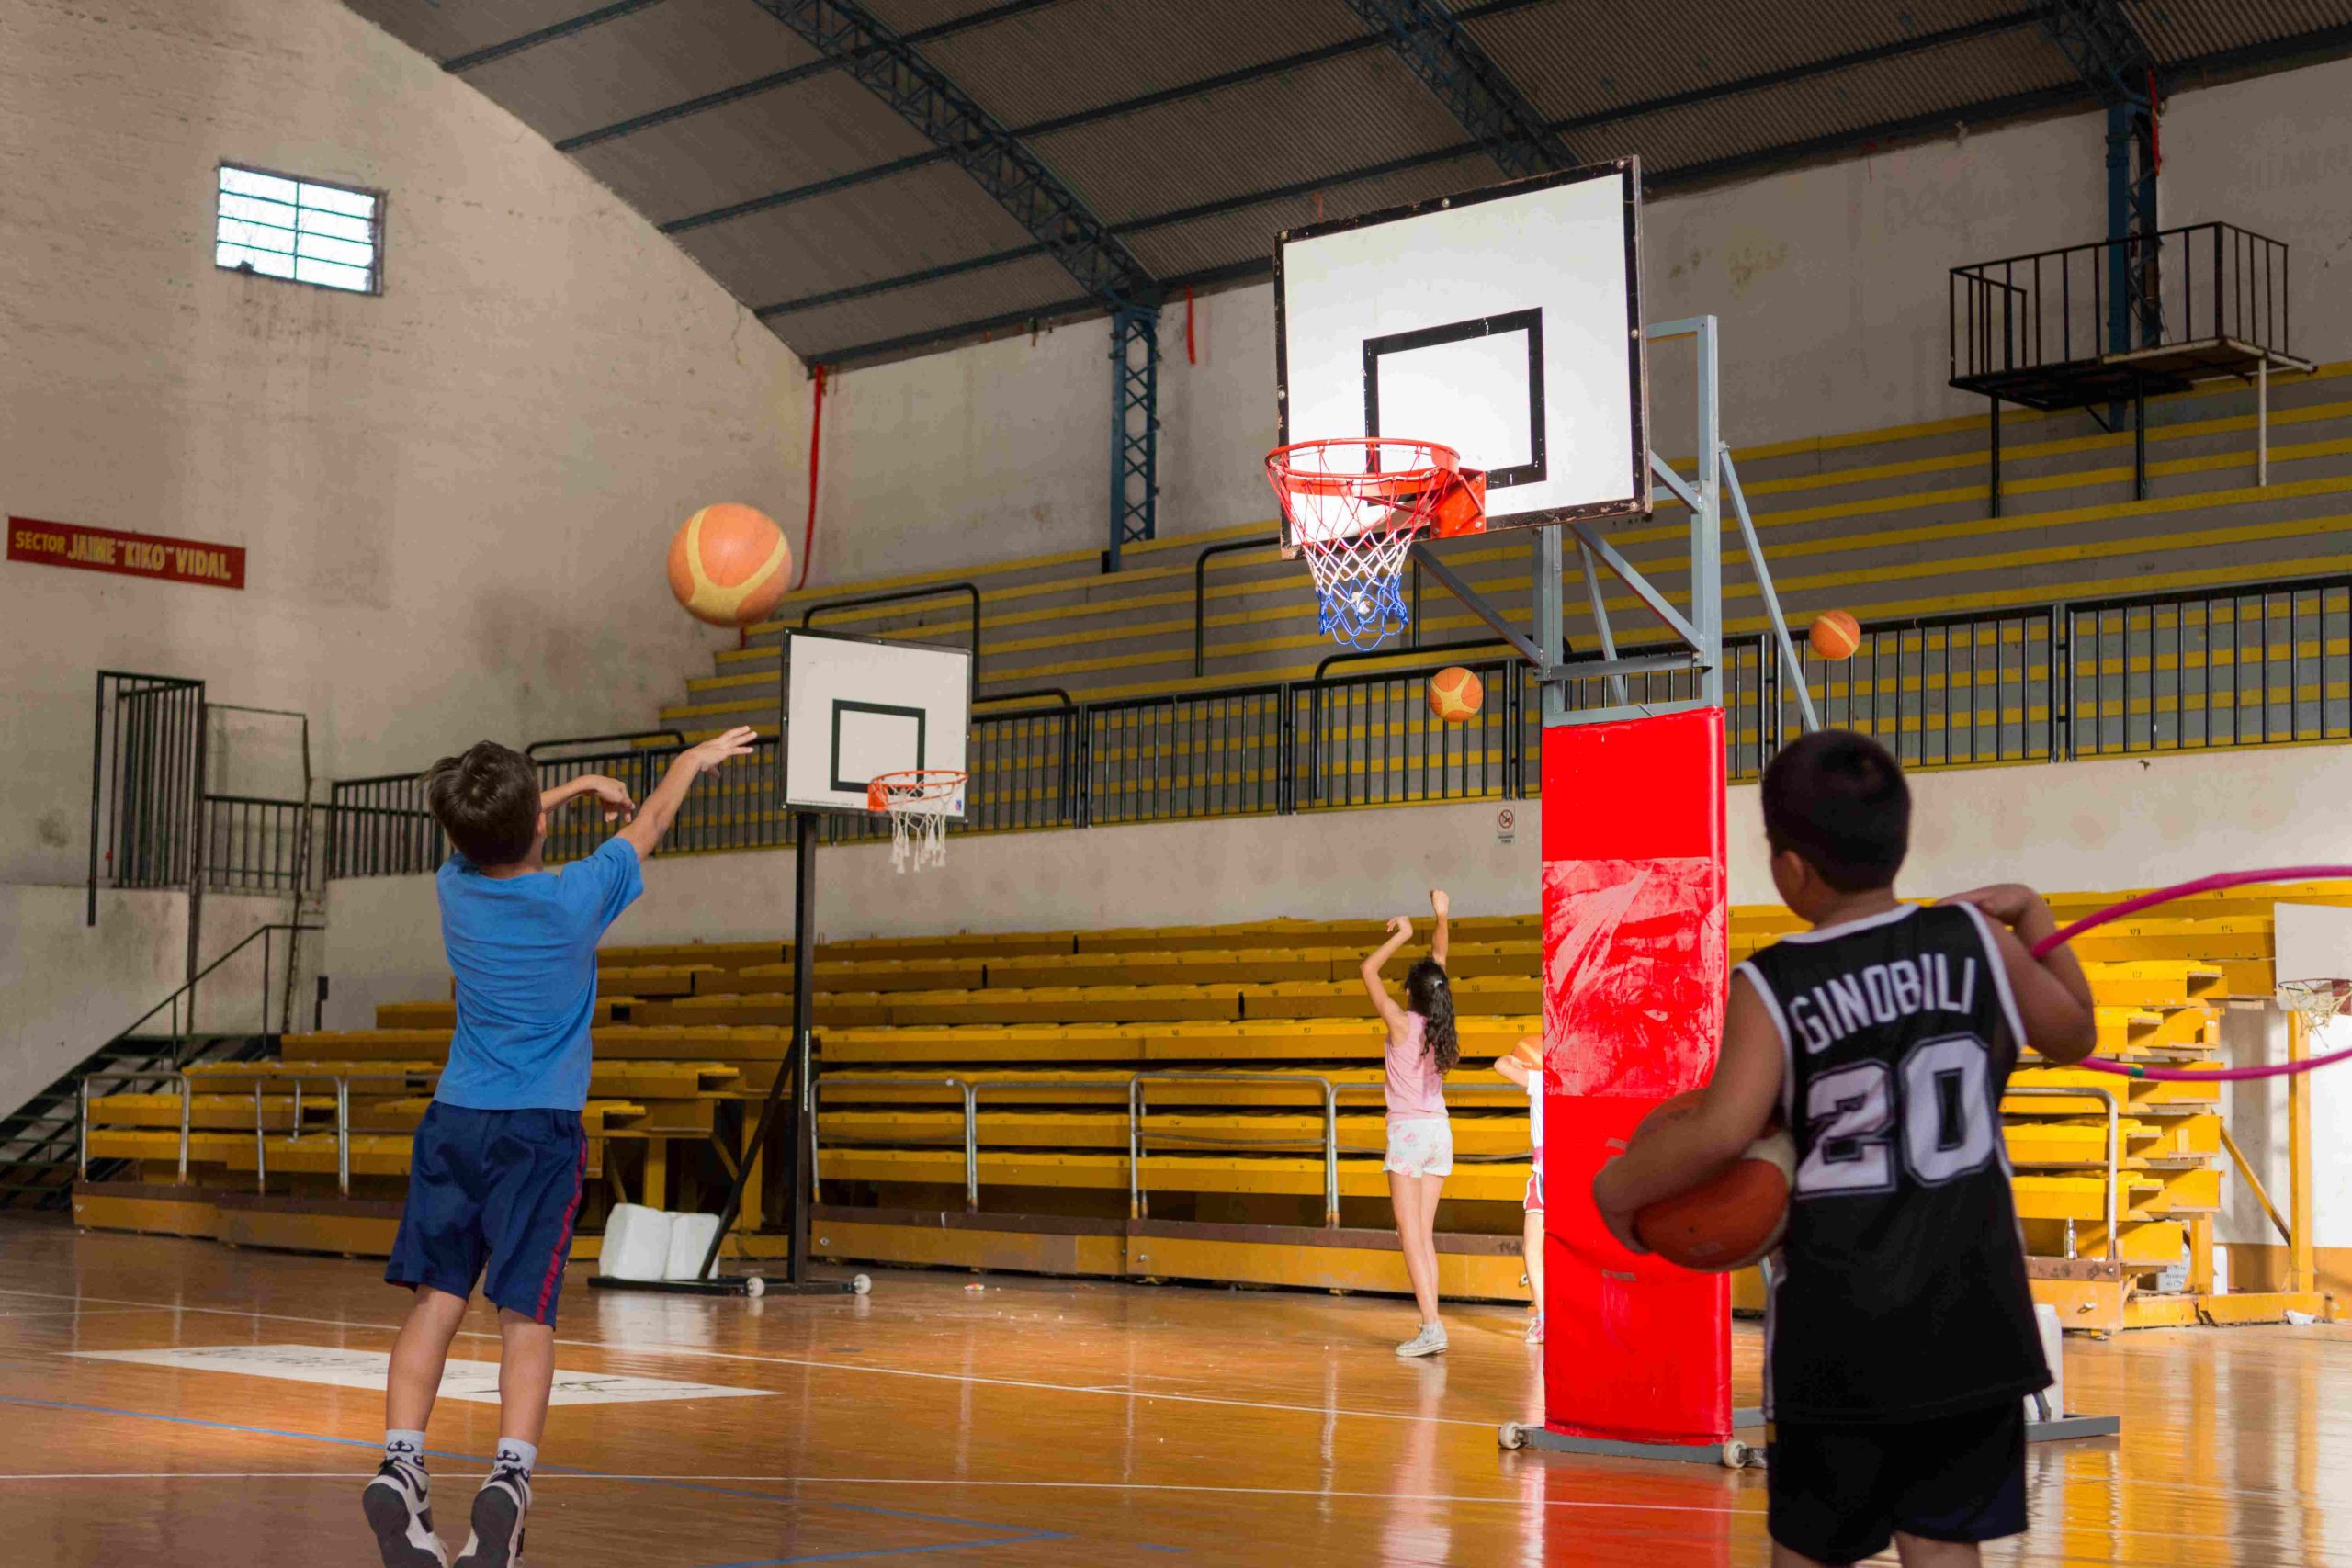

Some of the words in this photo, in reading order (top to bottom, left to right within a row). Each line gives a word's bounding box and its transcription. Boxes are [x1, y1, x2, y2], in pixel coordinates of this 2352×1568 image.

[15, 530, 66, 554] SECTOR
[67, 533, 116, 566] JAIME
[175, 547, 232, 580] VIDAL
[1788, 953, 1975, 1055] GINOBILI
[1795, 1031, 1996, 1201] 20
